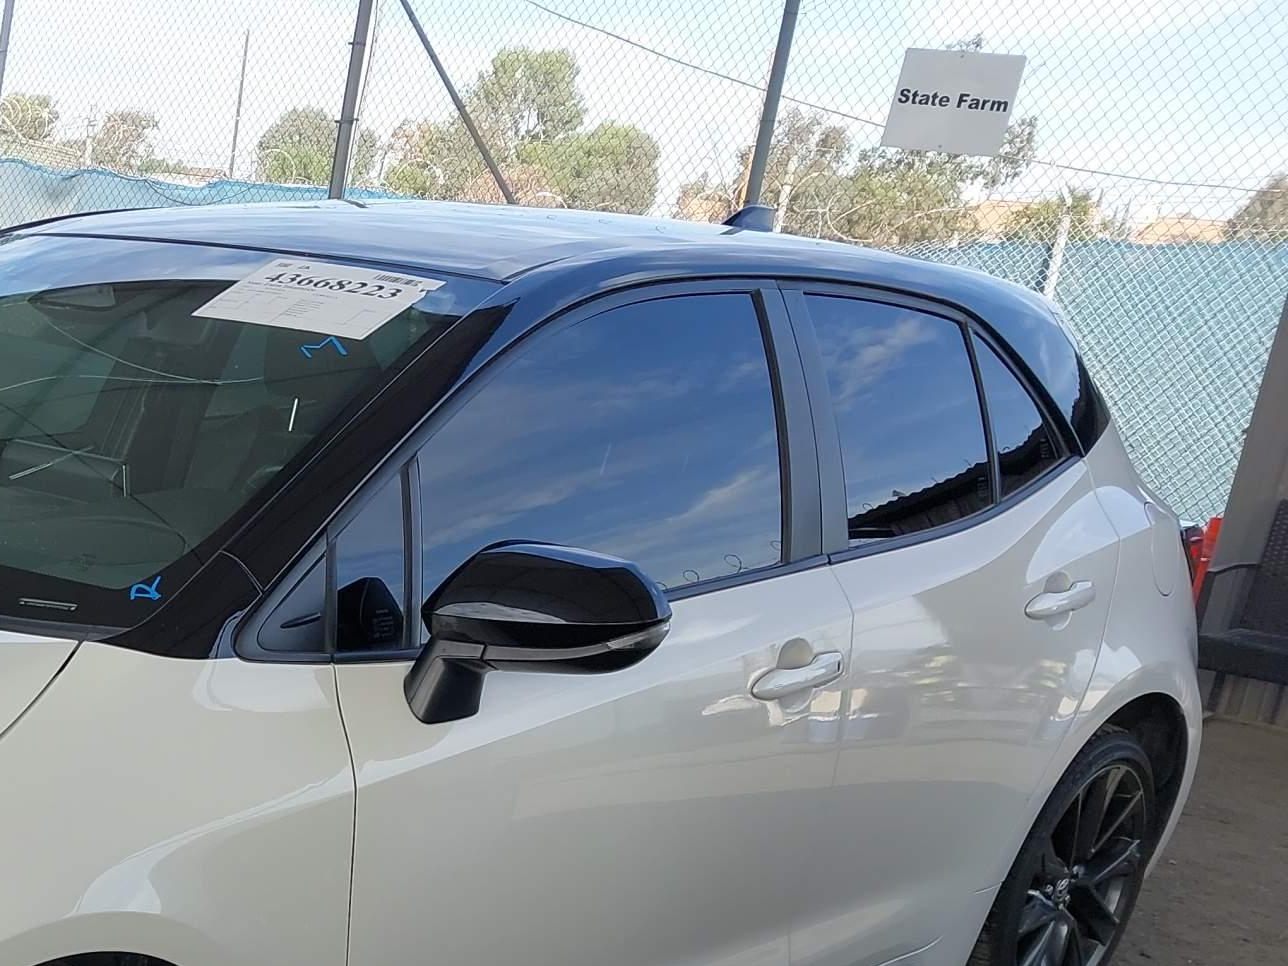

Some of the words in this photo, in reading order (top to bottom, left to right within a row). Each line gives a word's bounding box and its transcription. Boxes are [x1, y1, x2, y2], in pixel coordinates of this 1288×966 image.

[898, 88, 951, 108] State
[956, 93, 1009, 113] Farm
[264, 272, 403, 300] 43668223
